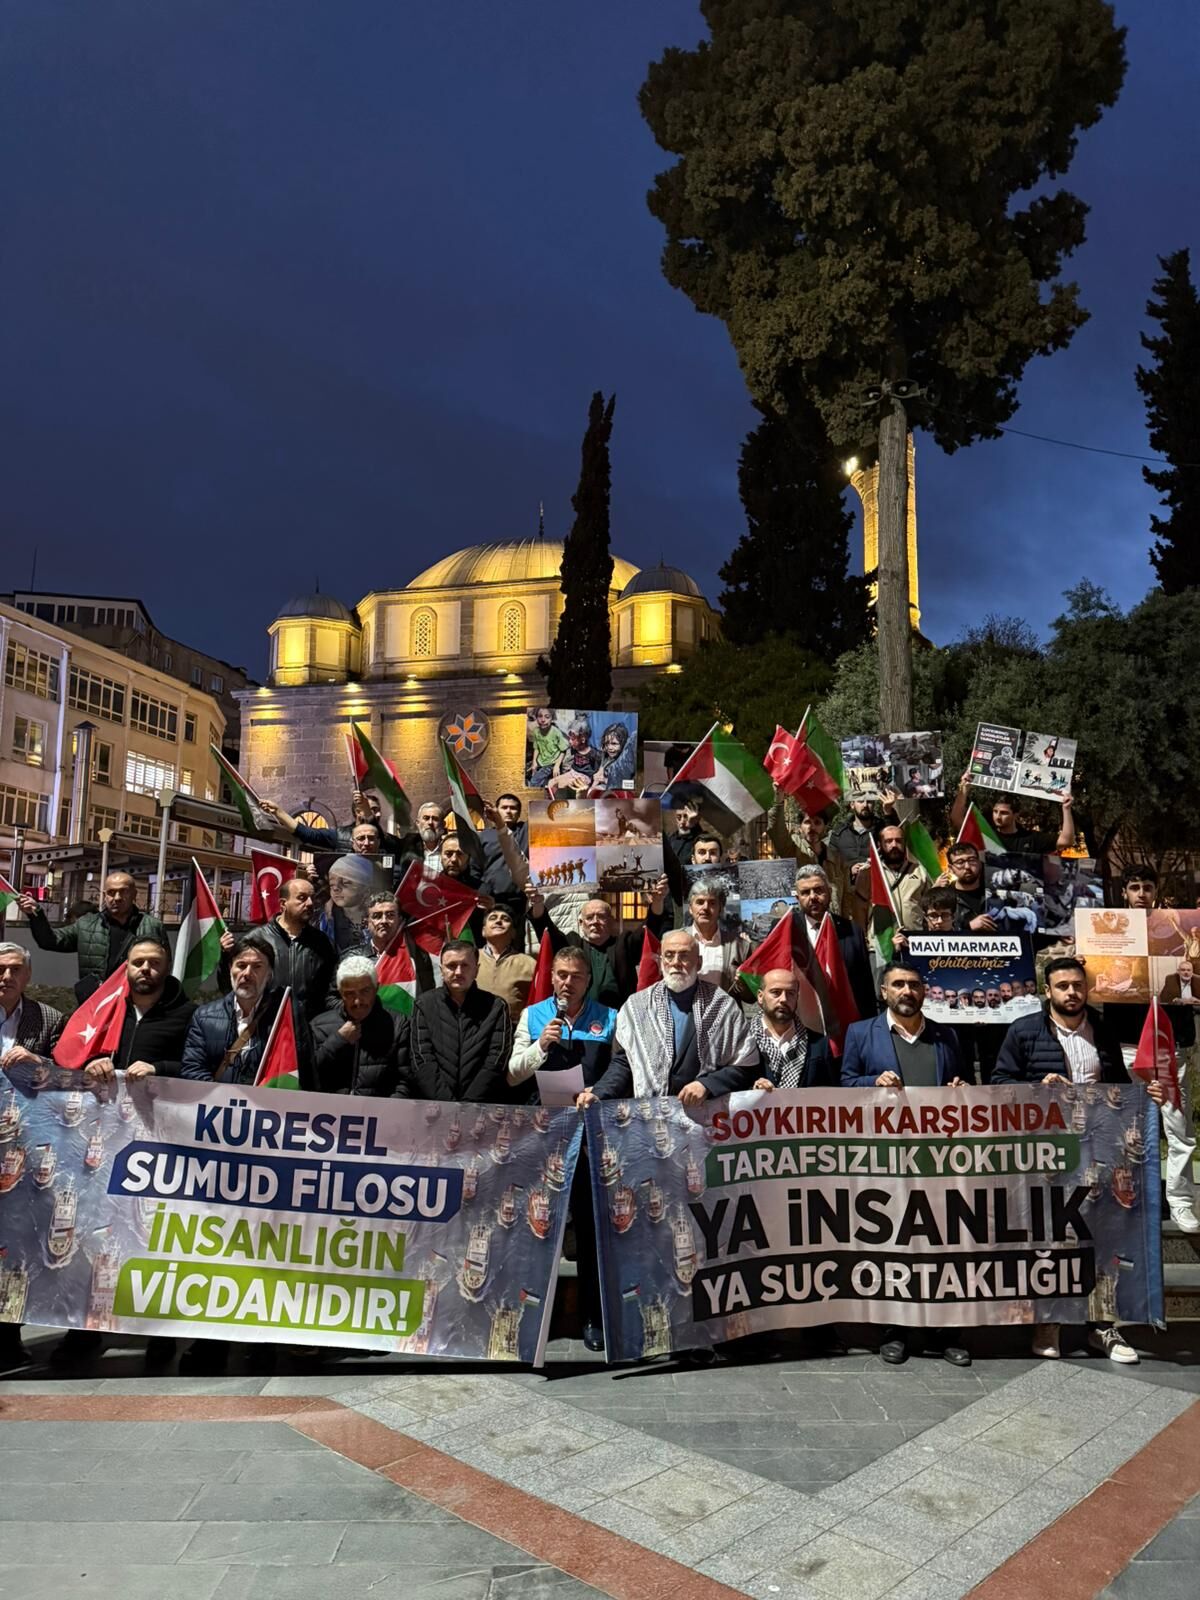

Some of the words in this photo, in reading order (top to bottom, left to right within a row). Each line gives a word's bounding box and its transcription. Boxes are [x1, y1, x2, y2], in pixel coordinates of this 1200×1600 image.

[911, 939, 945, 952] MAVİ
[948, 942, 1018, 952] MARMARA
[195, 1099, 387, 1156] KÜRESEL
[711, 1105, 862, 1142] SOYKIRIM
[874, 1102, 1066, 1139] KARŞISINDA
[121, 1152, 278, 1203] SUMUD
[291, 1161, 449, 1218] FİLOSU
[717, 1145, 920, 1181] TARAFSIZLIK
[928, 1142, 1067, 1174] YOKTUR:
[148, 1203, 406, 1272] İNSANLIĞIN
[689, 1193, 770, 1260] YA
[128, 1262, 410, 1332] VİCDANIDIR!
[701, 1272, 750, 1314] YA
[760, 1263, 839, 1301] SUÇ
[851, 1251, 1083, 1298] ORTAKLIĞI!
